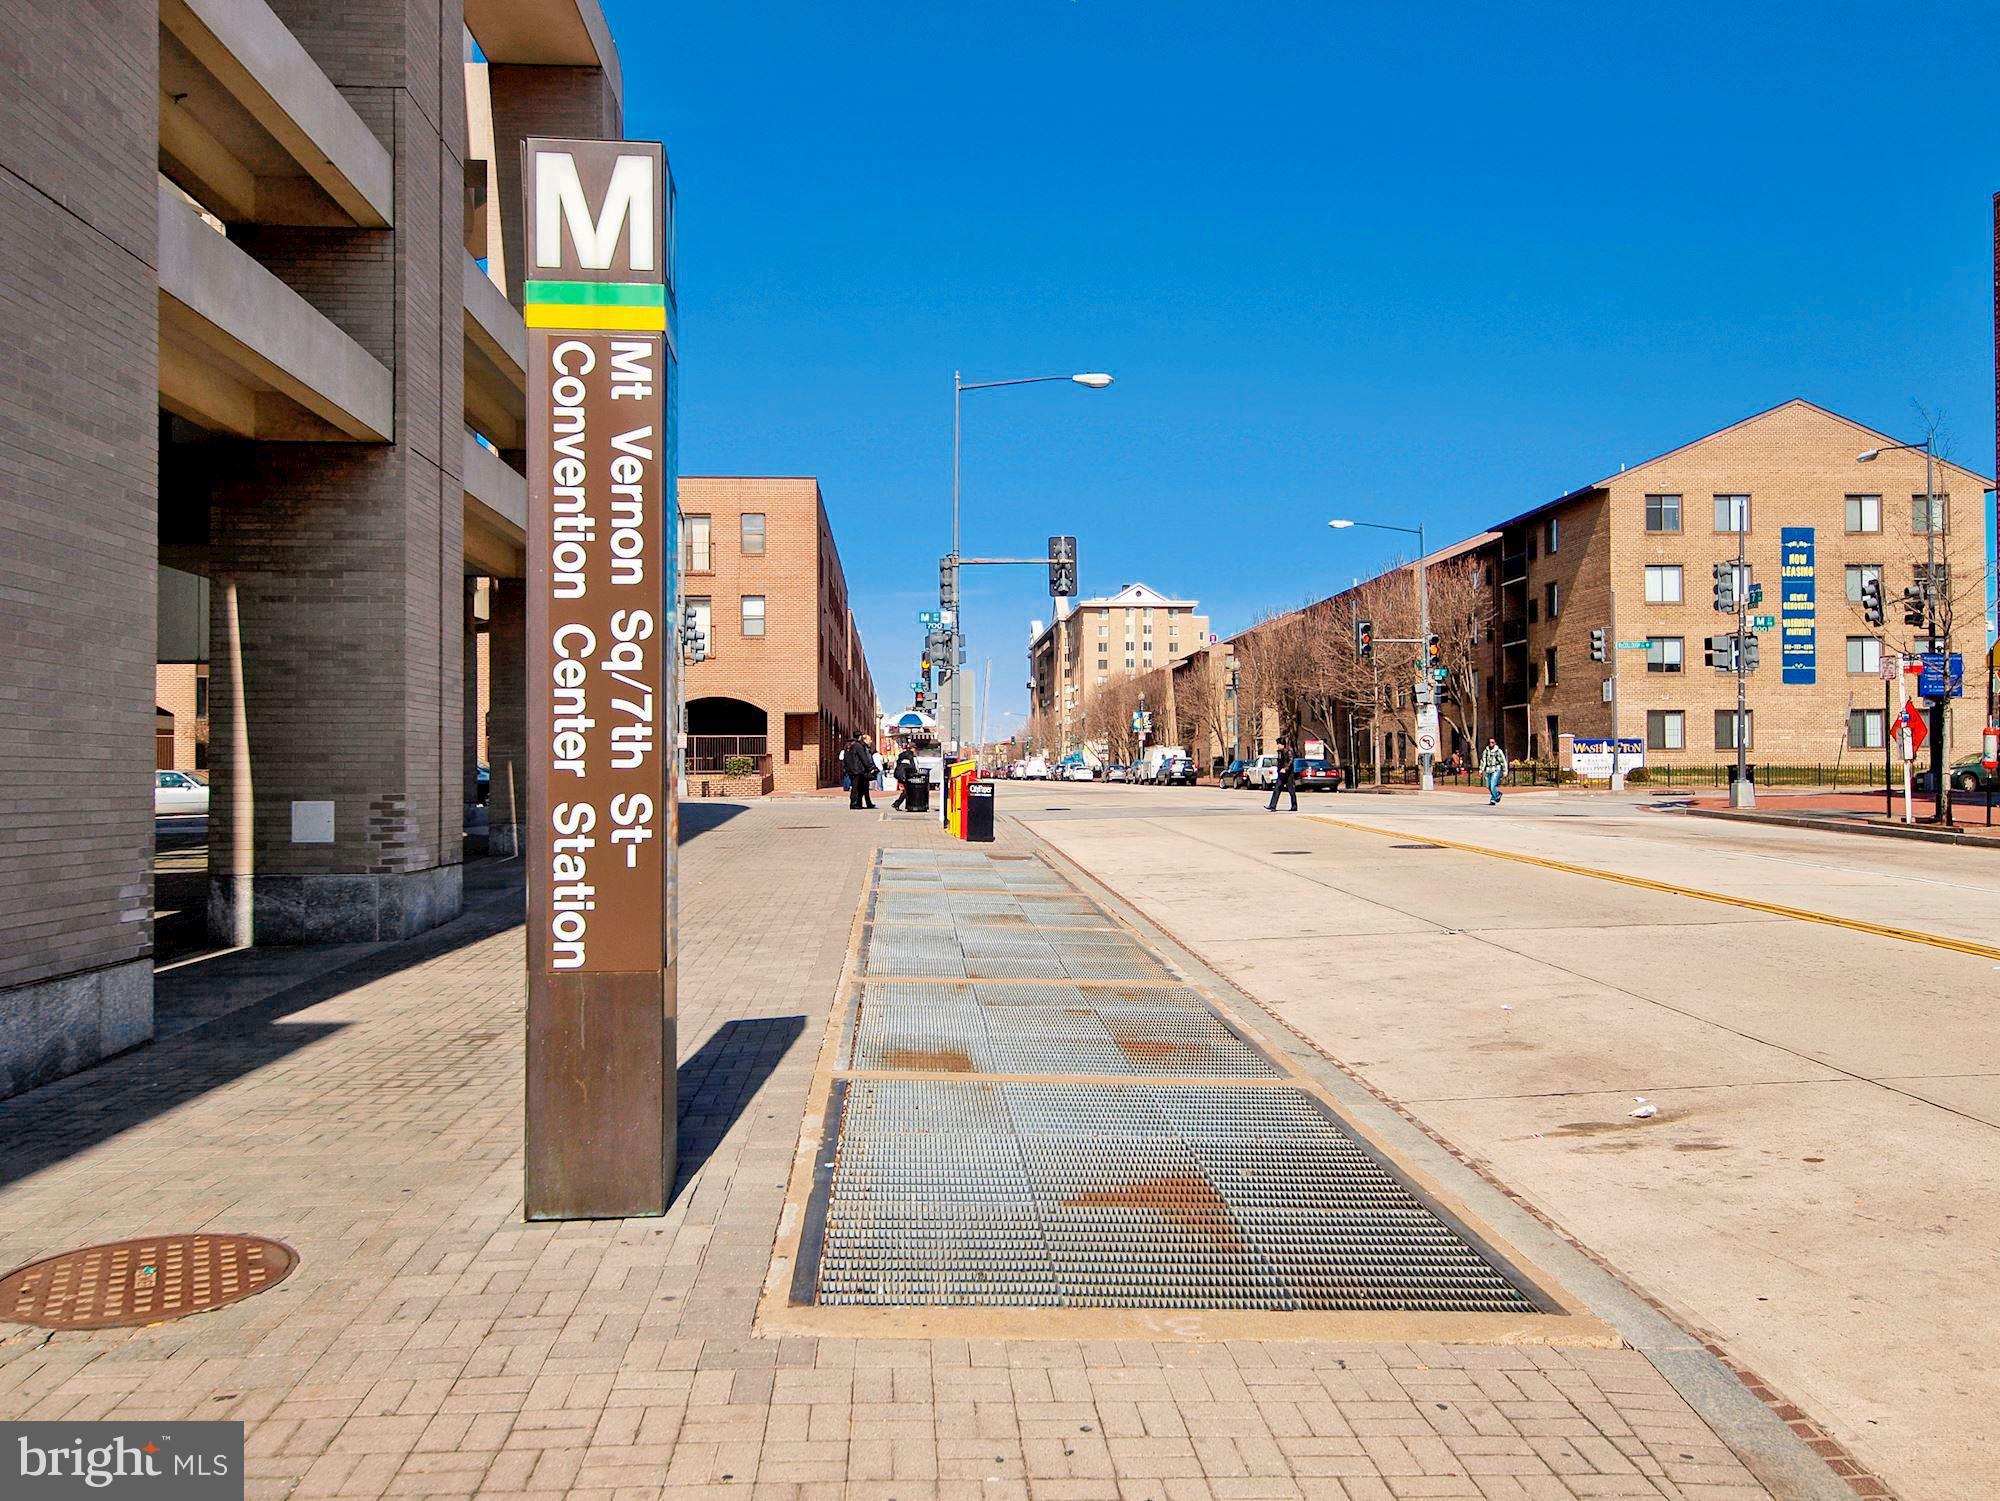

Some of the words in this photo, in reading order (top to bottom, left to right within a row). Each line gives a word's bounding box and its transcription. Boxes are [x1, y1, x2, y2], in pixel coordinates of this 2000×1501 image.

[535, 152, 655, 271] M
[609, 341, 653, 401] Mt
[551, 340, 596, 599] Convention
[609, 425, 653, 585] Vernon
[1782, 566, 1814, 577] LEASING
[1788, 554, 1807, 565] NOW
[920, 612, 930, 622] M
[1756, 617, 1765, 626] M
[552, 623, 597, 778] Center
[601, 609, 654, 769] Sq/7th
[610, 793, 653, 868] St-
[552, 802, 597, 969] Station
